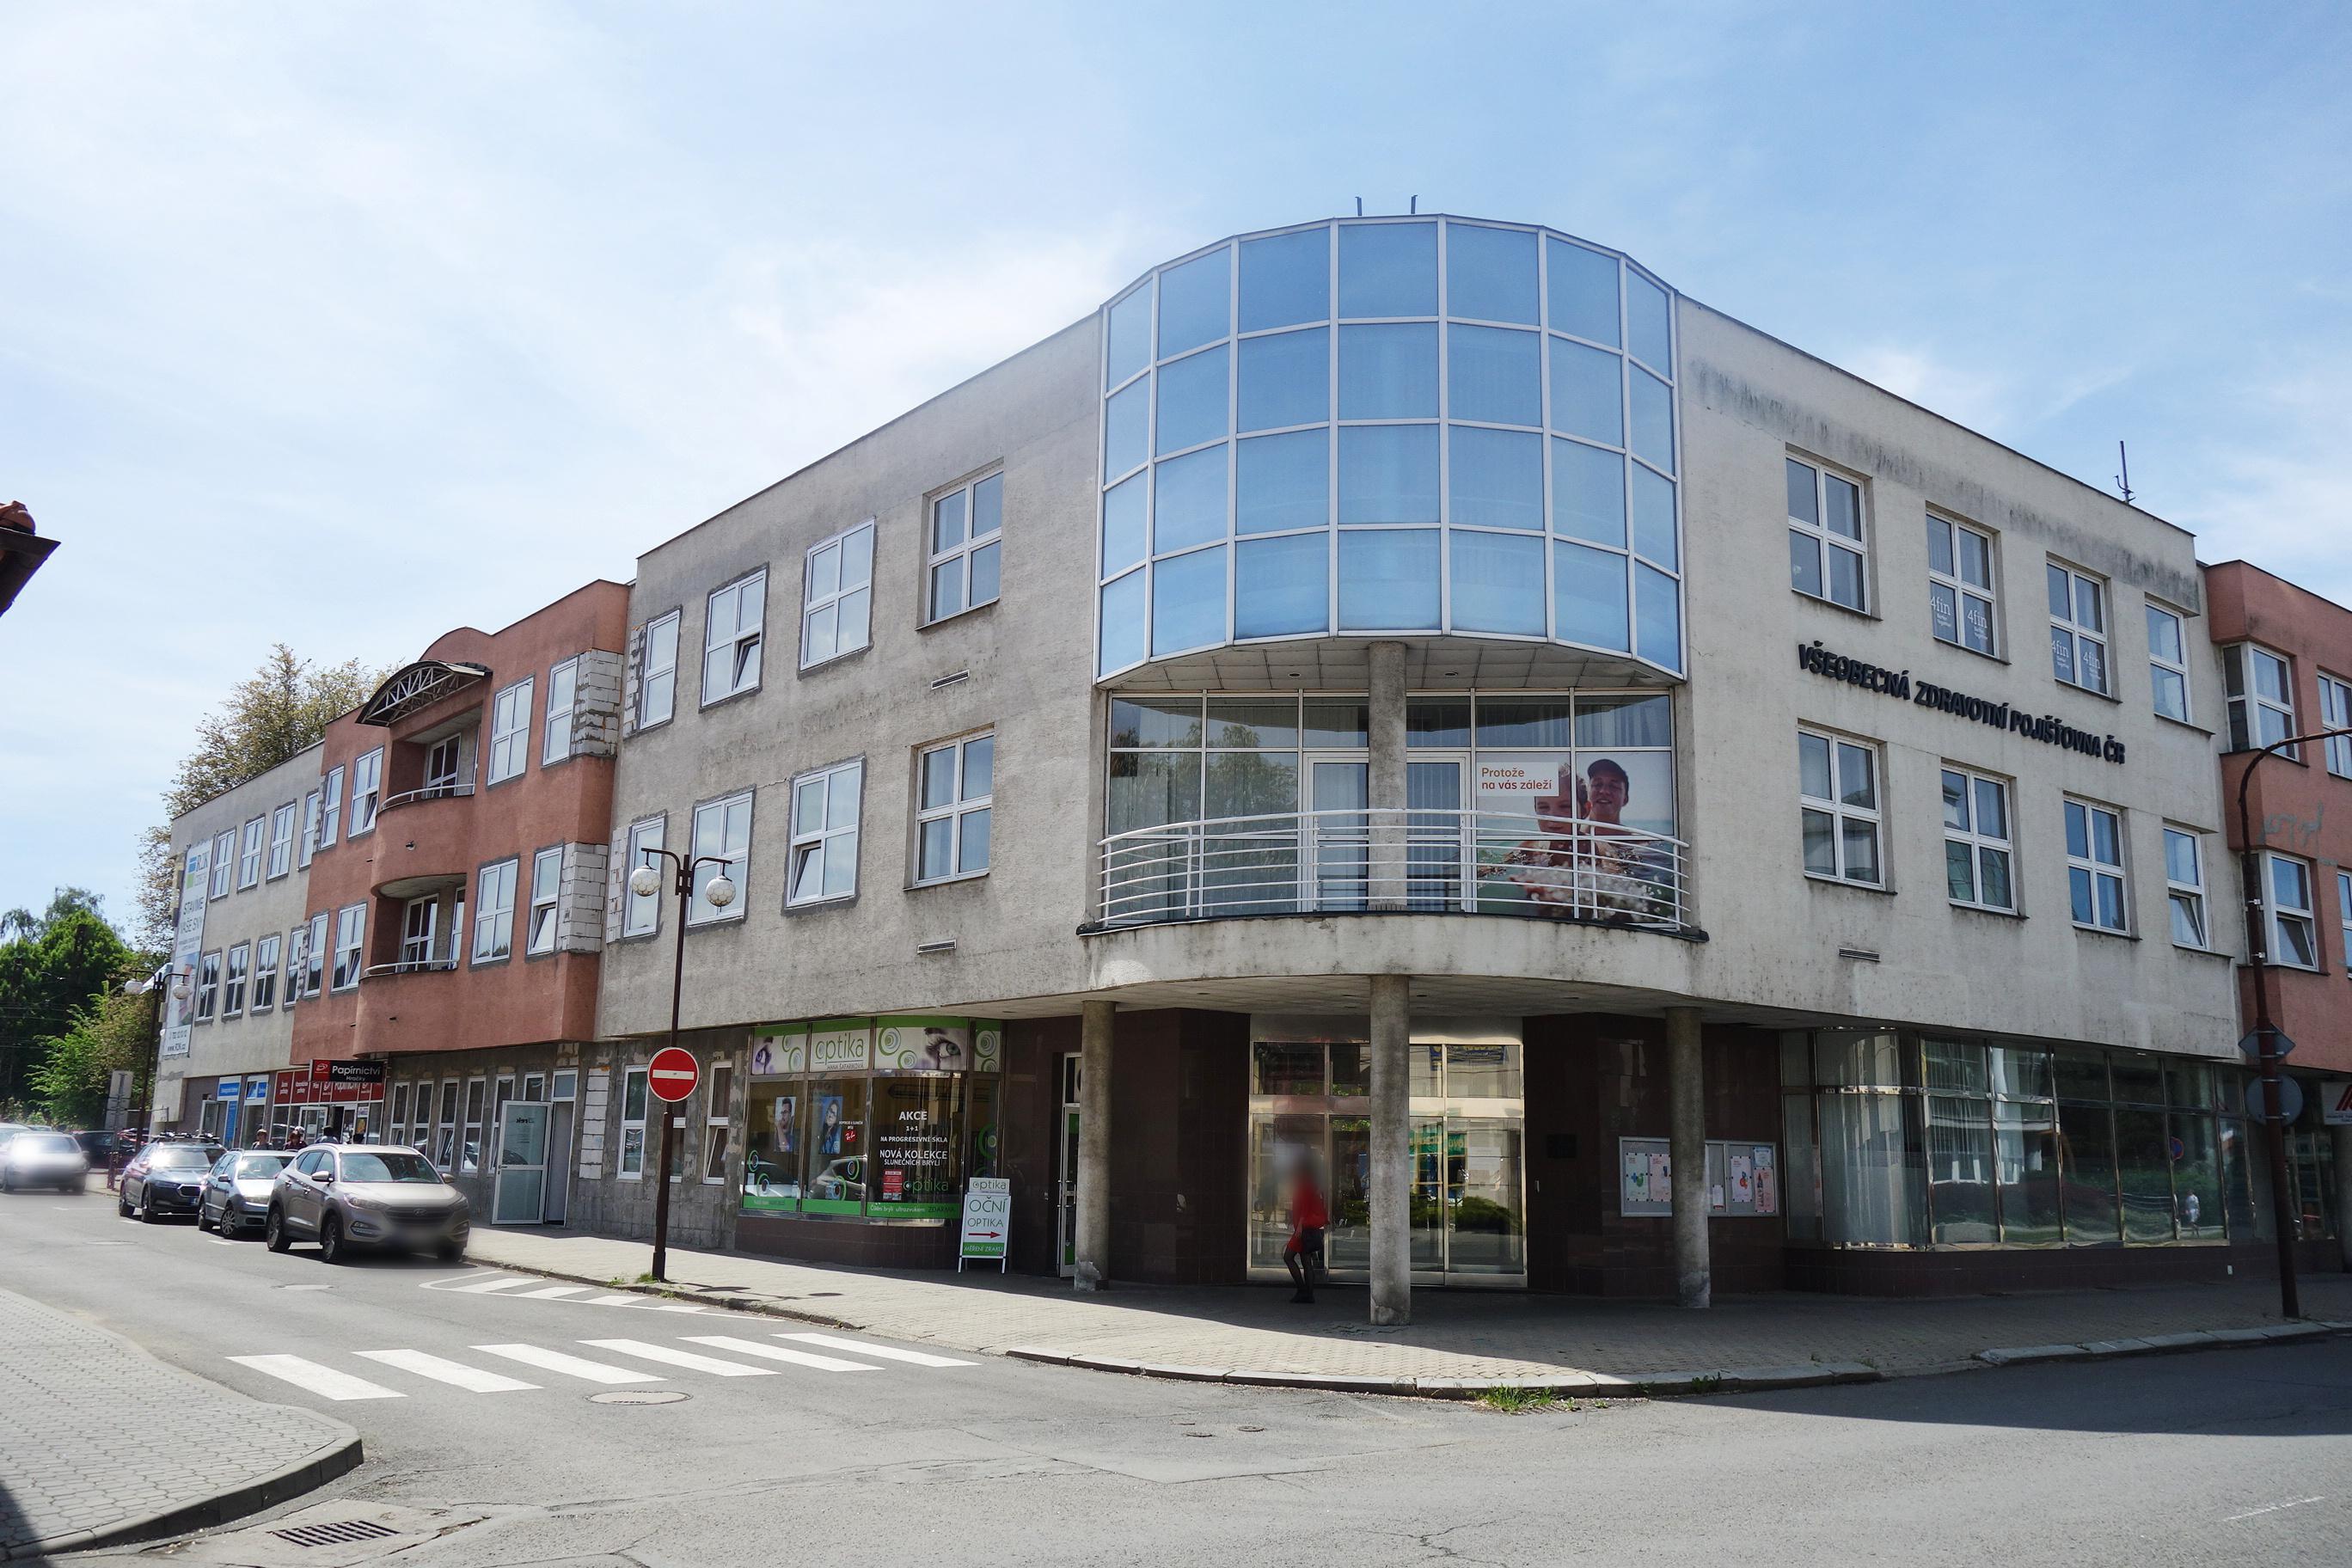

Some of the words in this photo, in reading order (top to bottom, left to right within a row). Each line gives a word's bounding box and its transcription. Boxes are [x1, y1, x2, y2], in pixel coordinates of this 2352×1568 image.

[1930, 596, 1951, 616] 4fin
[1967, 609, 1988, 628] 4fin
[2083, 651, 2101, 670] 4fin
[1798, 640, 1911, 701] VŠEOBECNÁ
[1914, 680, 2010, 729] ZDRAVOTNÍ
[2010, 710, 2103, 758] POJIŠŤOVNA
[2104, 734, 2125, 764] ČR
[1481, 767, 1525, 778] Protože
[1481, 781, 1495, 790] na
[1498, 780, 1517, 790] vás
[1520, 780, 1553, 790] záleží
[815, 1032, 864, 1065] optika
[332, 1065, 381, 1076] Papírnictví
[898, 1110, 928, 1121] AKCE
[889, 1134, 930, 1142] PROGRESIVNÍ
[879, 1148, 903, 1159] NOVÁ
[904, 1150, 947, 1160] KOLEKCE
[884, 1157, 920, 1166] SLUNEČNÍCH
[922, 1158, 940, 1167] BRÝLÍ
[903, 1179, 949, 1193] optika
[972, 1180, 1007, 1190] optika
[969, 1196, 1008, 1213] OČNÍ
[967, 1217, 1004, 1228] OPTIKA
